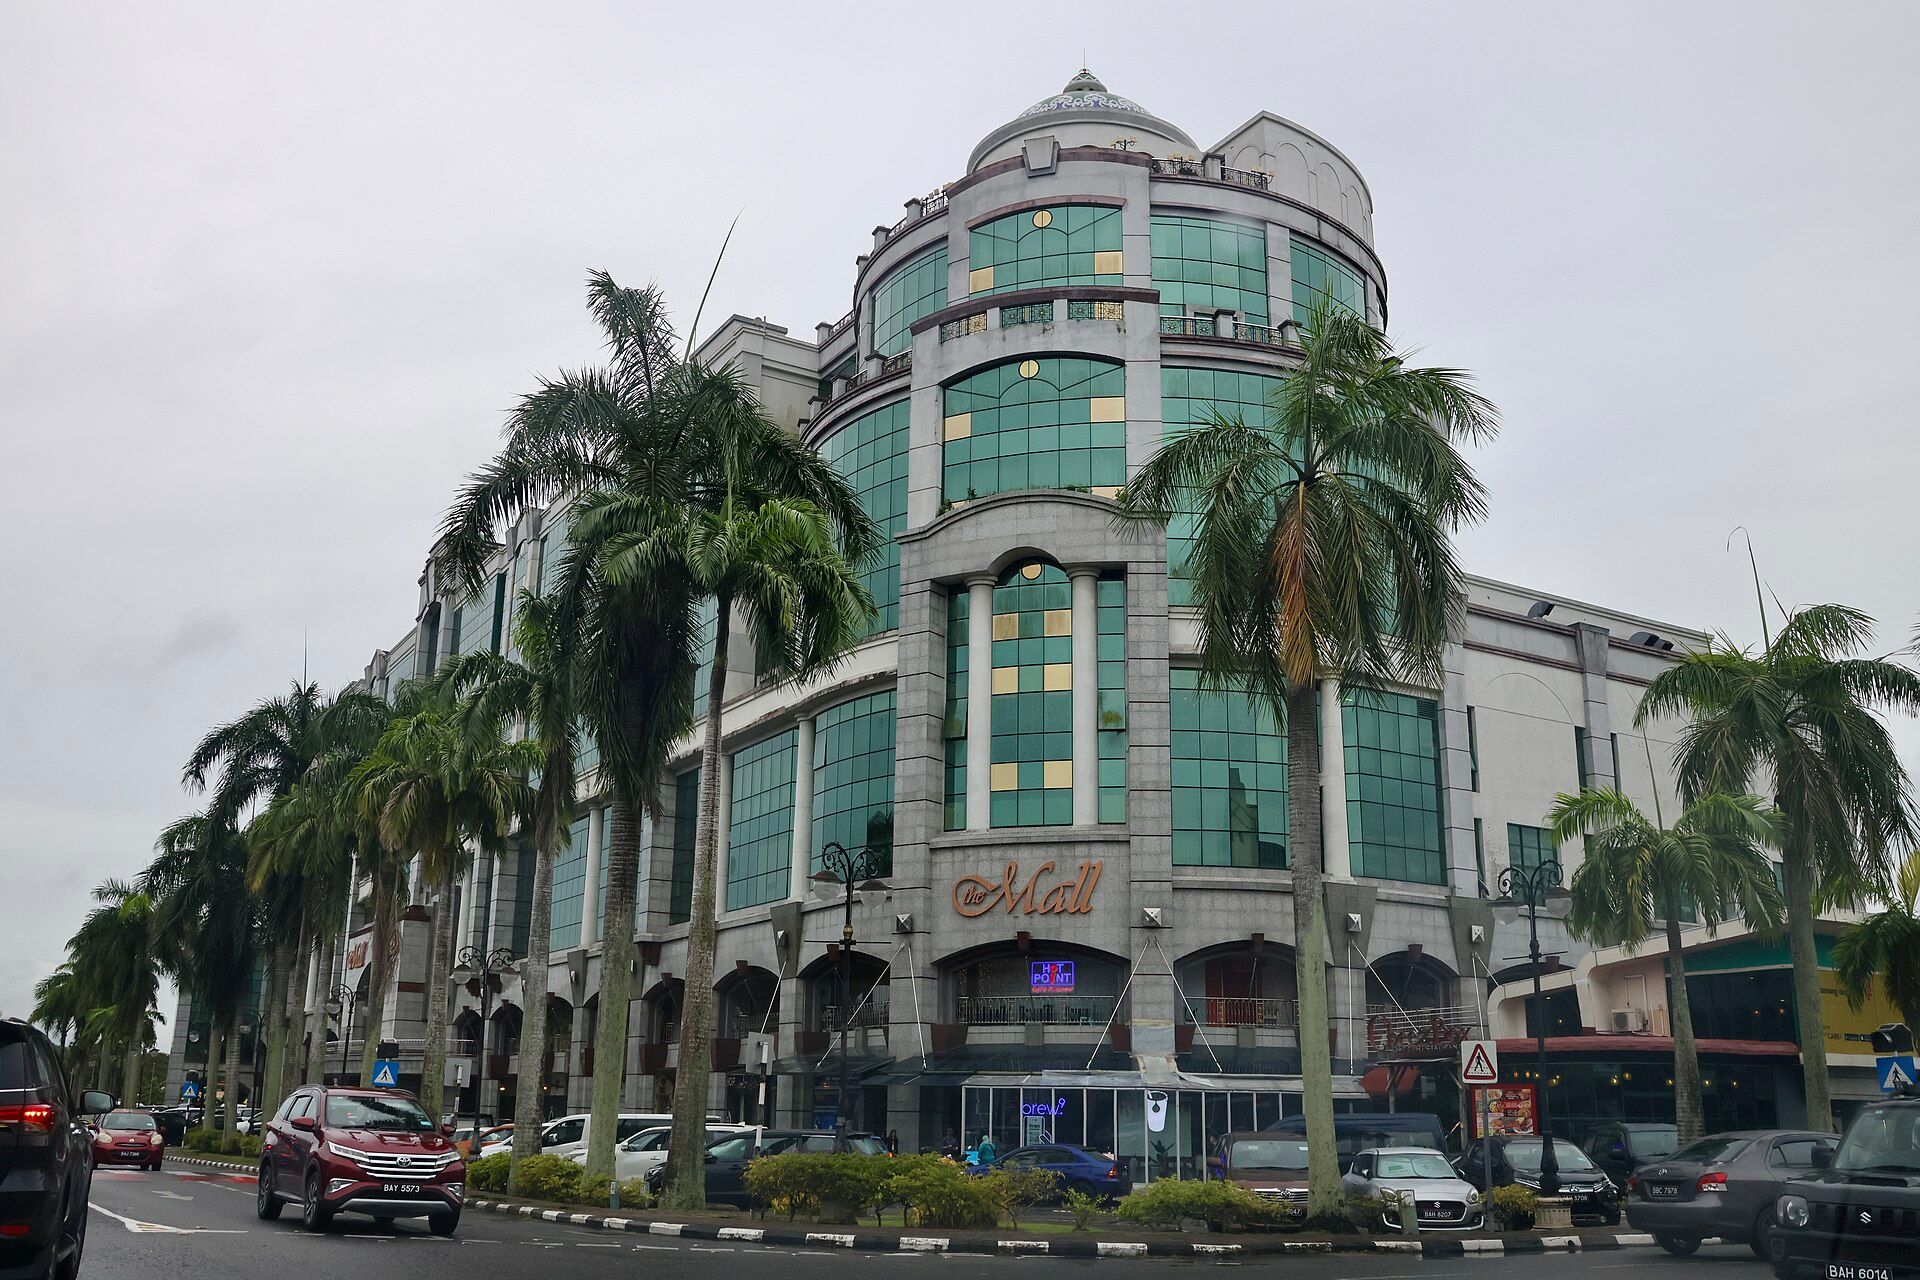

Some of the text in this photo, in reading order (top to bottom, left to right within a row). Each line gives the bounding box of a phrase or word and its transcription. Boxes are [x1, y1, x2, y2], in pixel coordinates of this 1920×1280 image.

[952, 860, 1103, 917] the Mall
[1033, 973, 1072, 984] POINT
[383, 1183, 421, 1193] BAY 5573
[1829, 1264, 1889, 1280] BAH 6014
